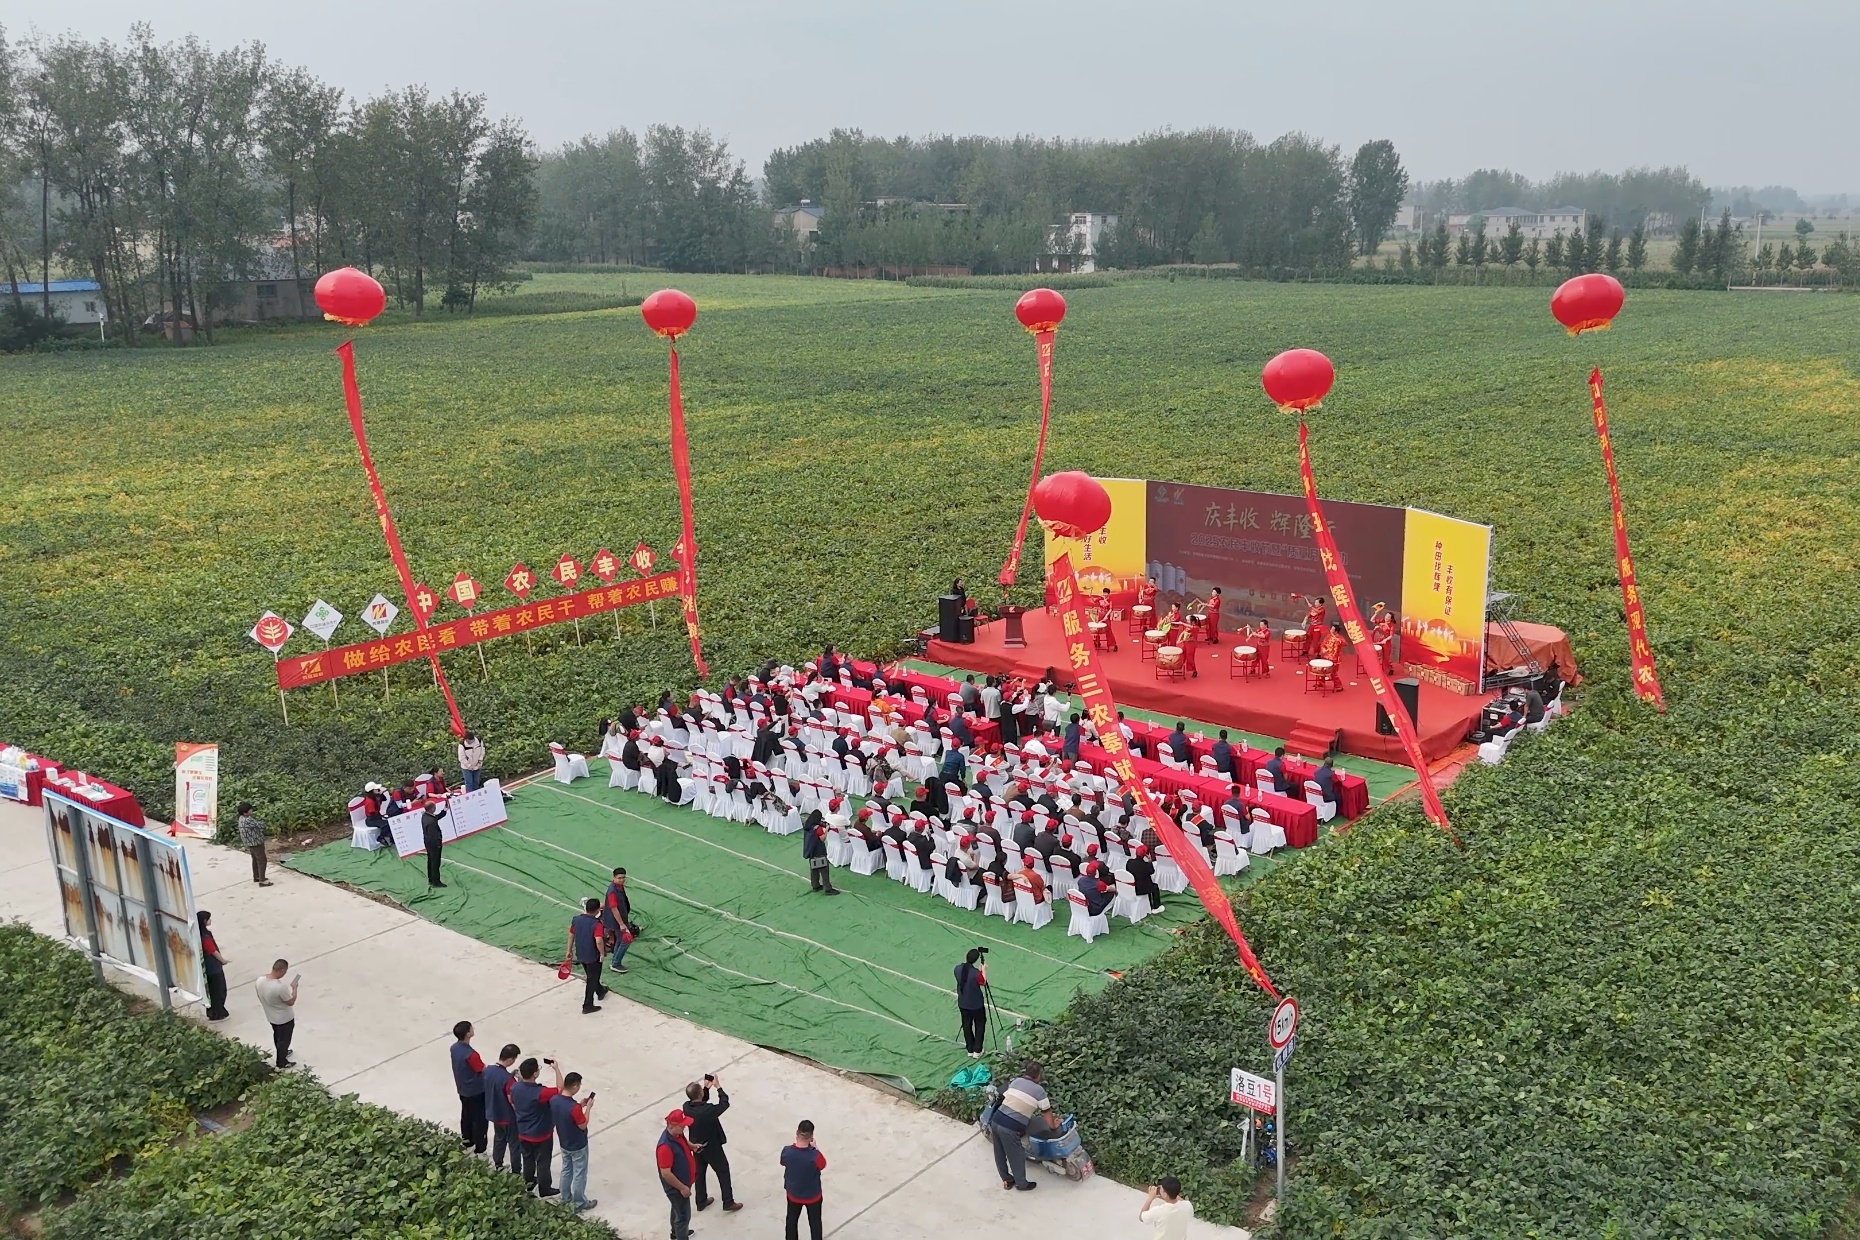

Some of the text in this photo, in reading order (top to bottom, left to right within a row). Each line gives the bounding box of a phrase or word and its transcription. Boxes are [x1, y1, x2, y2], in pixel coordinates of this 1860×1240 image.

[1204, 501, 1260, 533] 庆丰收
[1433, 540, 1443, 592] 种田找辉隆
[1444, 564, 1454, 616] 丰收有保证
[343, 576, 679, 670] 做给农民看 带着农民干 帮着农民赚
[1235, 1073, 1273, 1104] 洛豆1号
